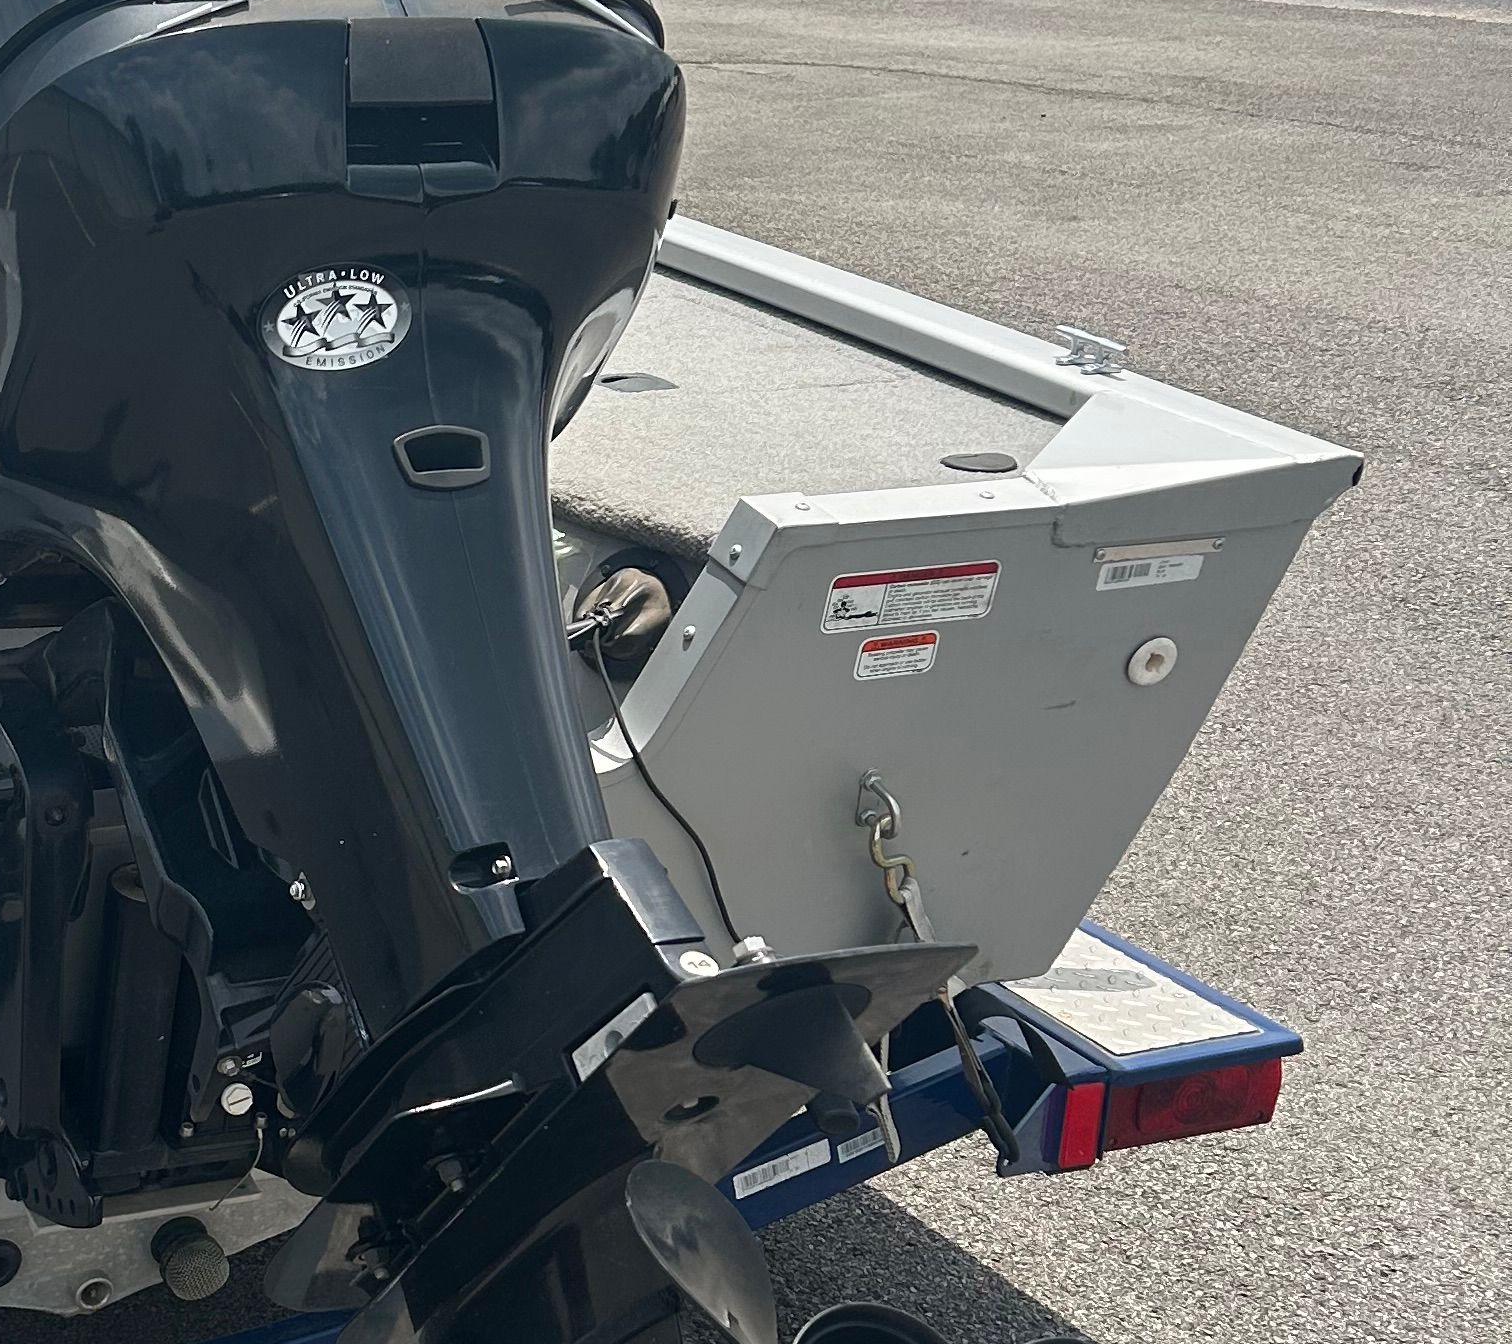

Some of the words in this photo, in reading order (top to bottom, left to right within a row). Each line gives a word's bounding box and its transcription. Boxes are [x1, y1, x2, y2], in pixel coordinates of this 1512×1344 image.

[283, 269, 338, 299] ULTRA
[349, 268, 385, 285] LOW
[305, 345, 387, 368] EMISSION
